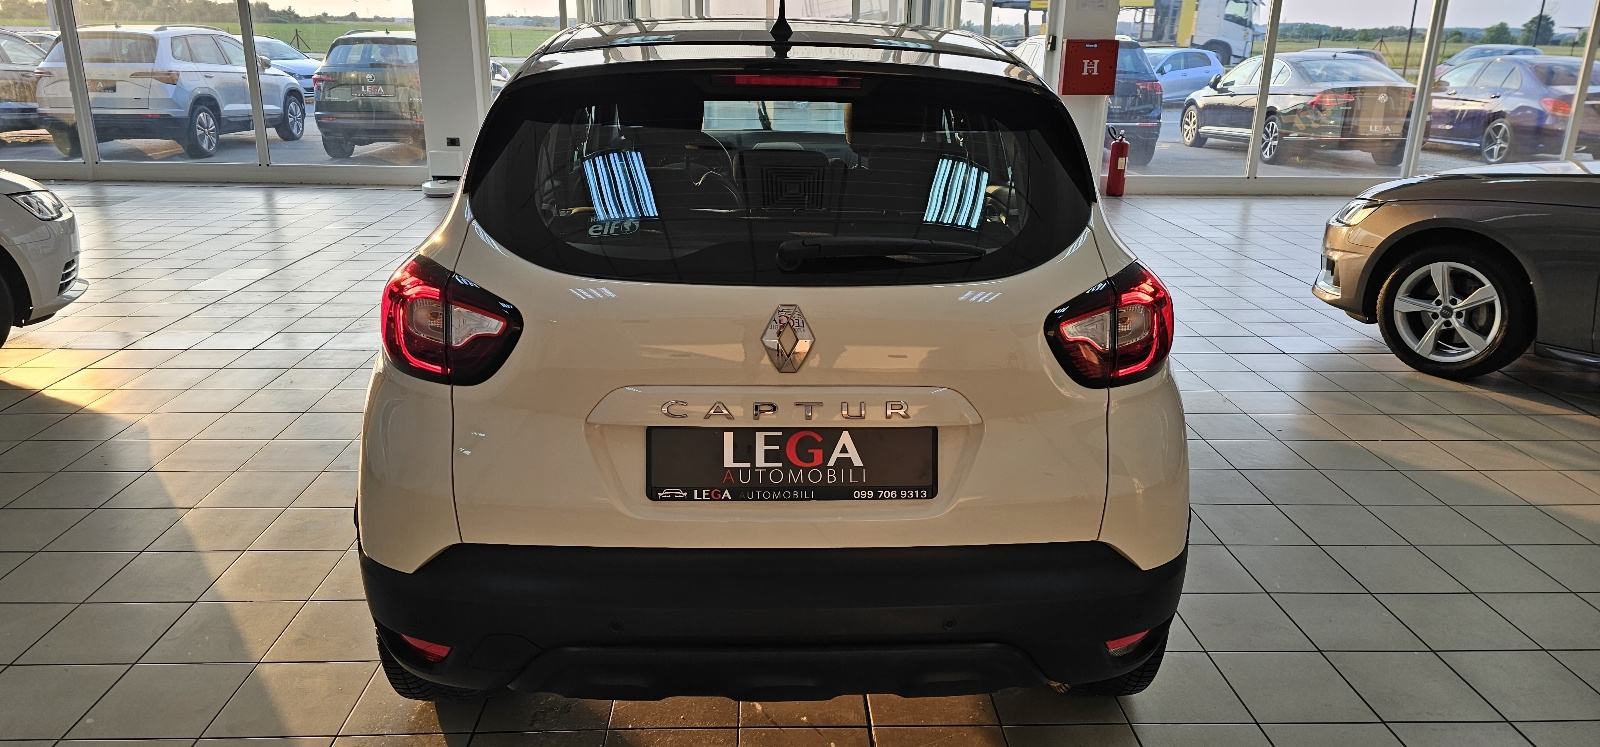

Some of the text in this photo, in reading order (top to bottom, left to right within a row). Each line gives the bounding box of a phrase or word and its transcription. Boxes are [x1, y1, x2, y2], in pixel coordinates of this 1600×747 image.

[361, 85, 384, 93] LEGA
[588, 220, 620, 236] elf
[660, 400, 911, 421] CAPTUR
[723, 430, 864, 468] LEGA
[722, 468, 867, 484] AUTOMOBILI
[693, 489, 732, 500] LEGA
[853, 490, 927, 499] 099 706 9313
